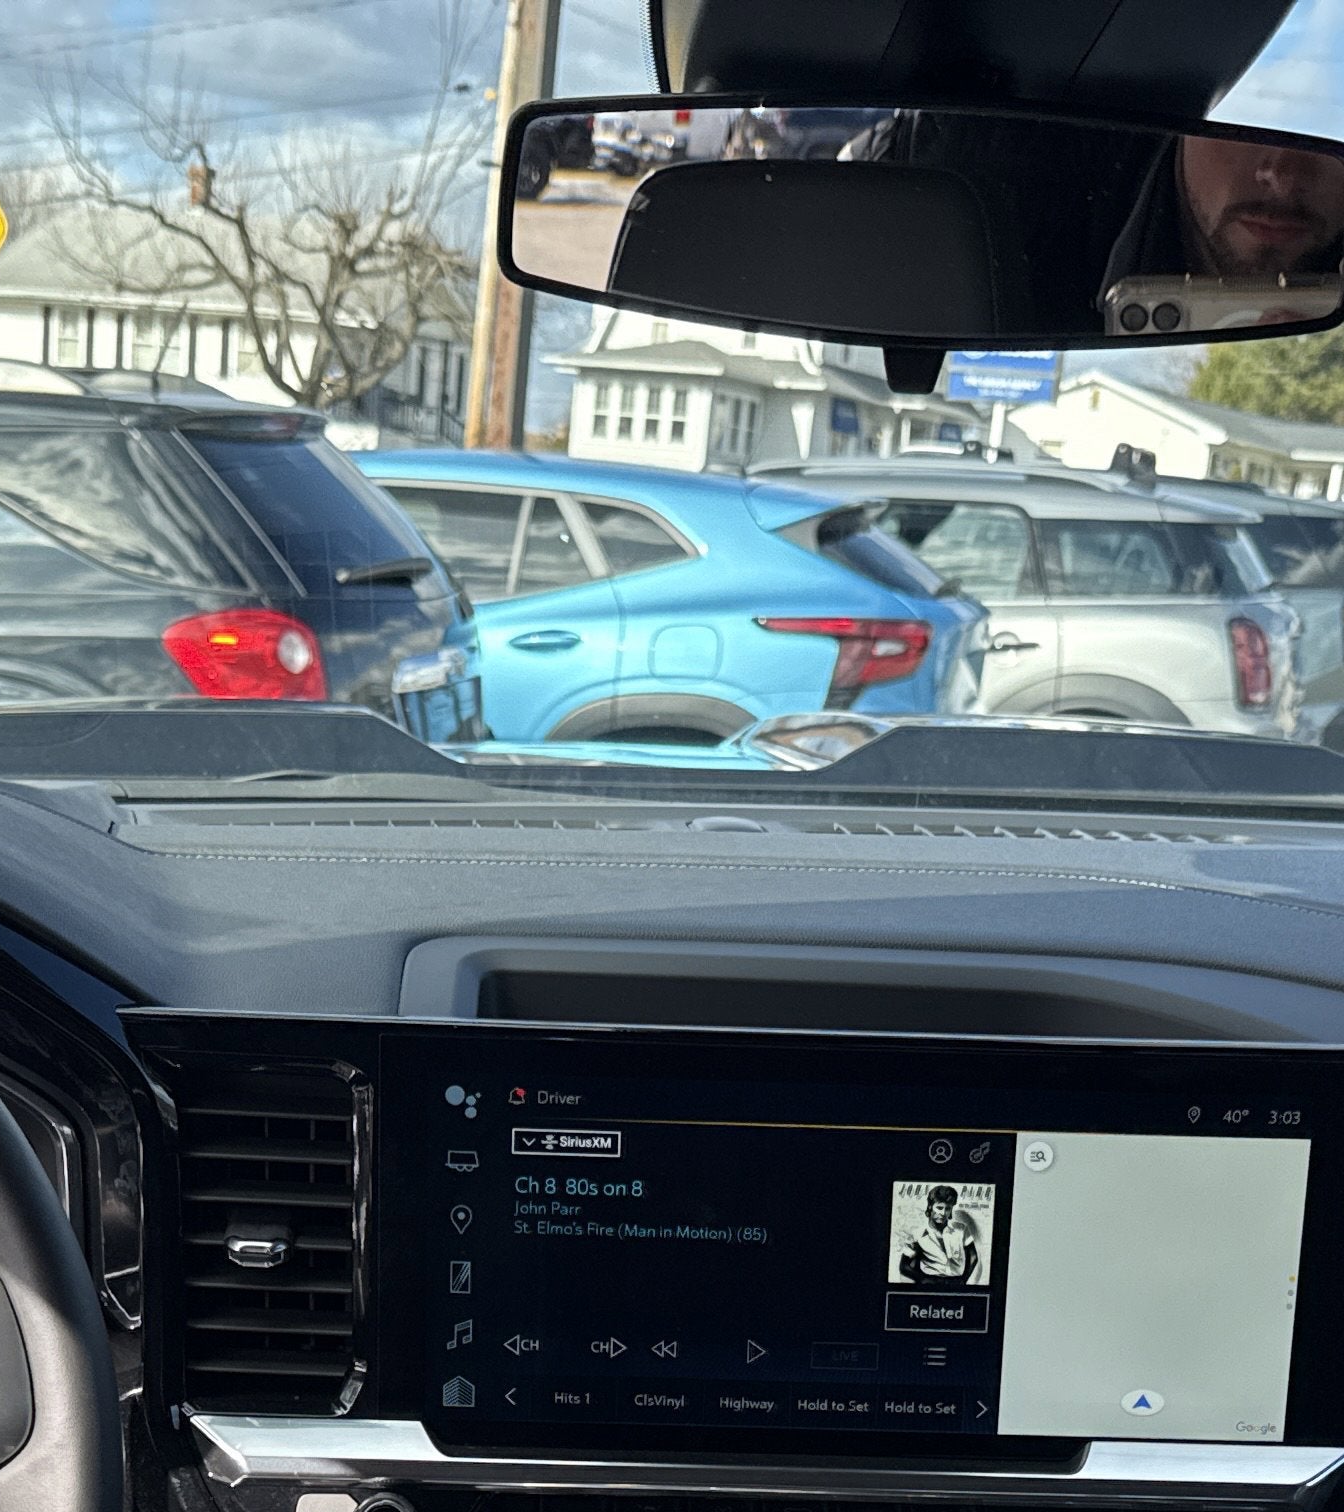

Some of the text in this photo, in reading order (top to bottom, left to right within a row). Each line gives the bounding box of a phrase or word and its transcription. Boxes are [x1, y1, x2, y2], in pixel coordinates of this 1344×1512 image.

[537, 1091, 582, 1105] Driver
[1267, 1110, 1302, 1125] 3:03
[559, 1136, 612, 1149] SiriusXM
[515, 1176, 643, 1197] Ch 8 80s on 8
[514, 1201, 582, 1216] John Parr
[513, 1221, 768, 1244] St. Elmo's Fire (Man in Motion) (85)
[909, 1305, 964, 1320] Related
[520, 1340, 540, 1351] CH
[590, 1341, 609, 1353] CH
[554, 1392, 591, 1405] Hits 1
[634, 1393, 685, 1411] ClsVinyl
[719, 1396, 775, 1414] Highway
[798, 1399, 870, 1413] Hold to Set
[885, 1402, 956, 1415] Hold to Set
[1236, 1421, 1277, 1435] Google
